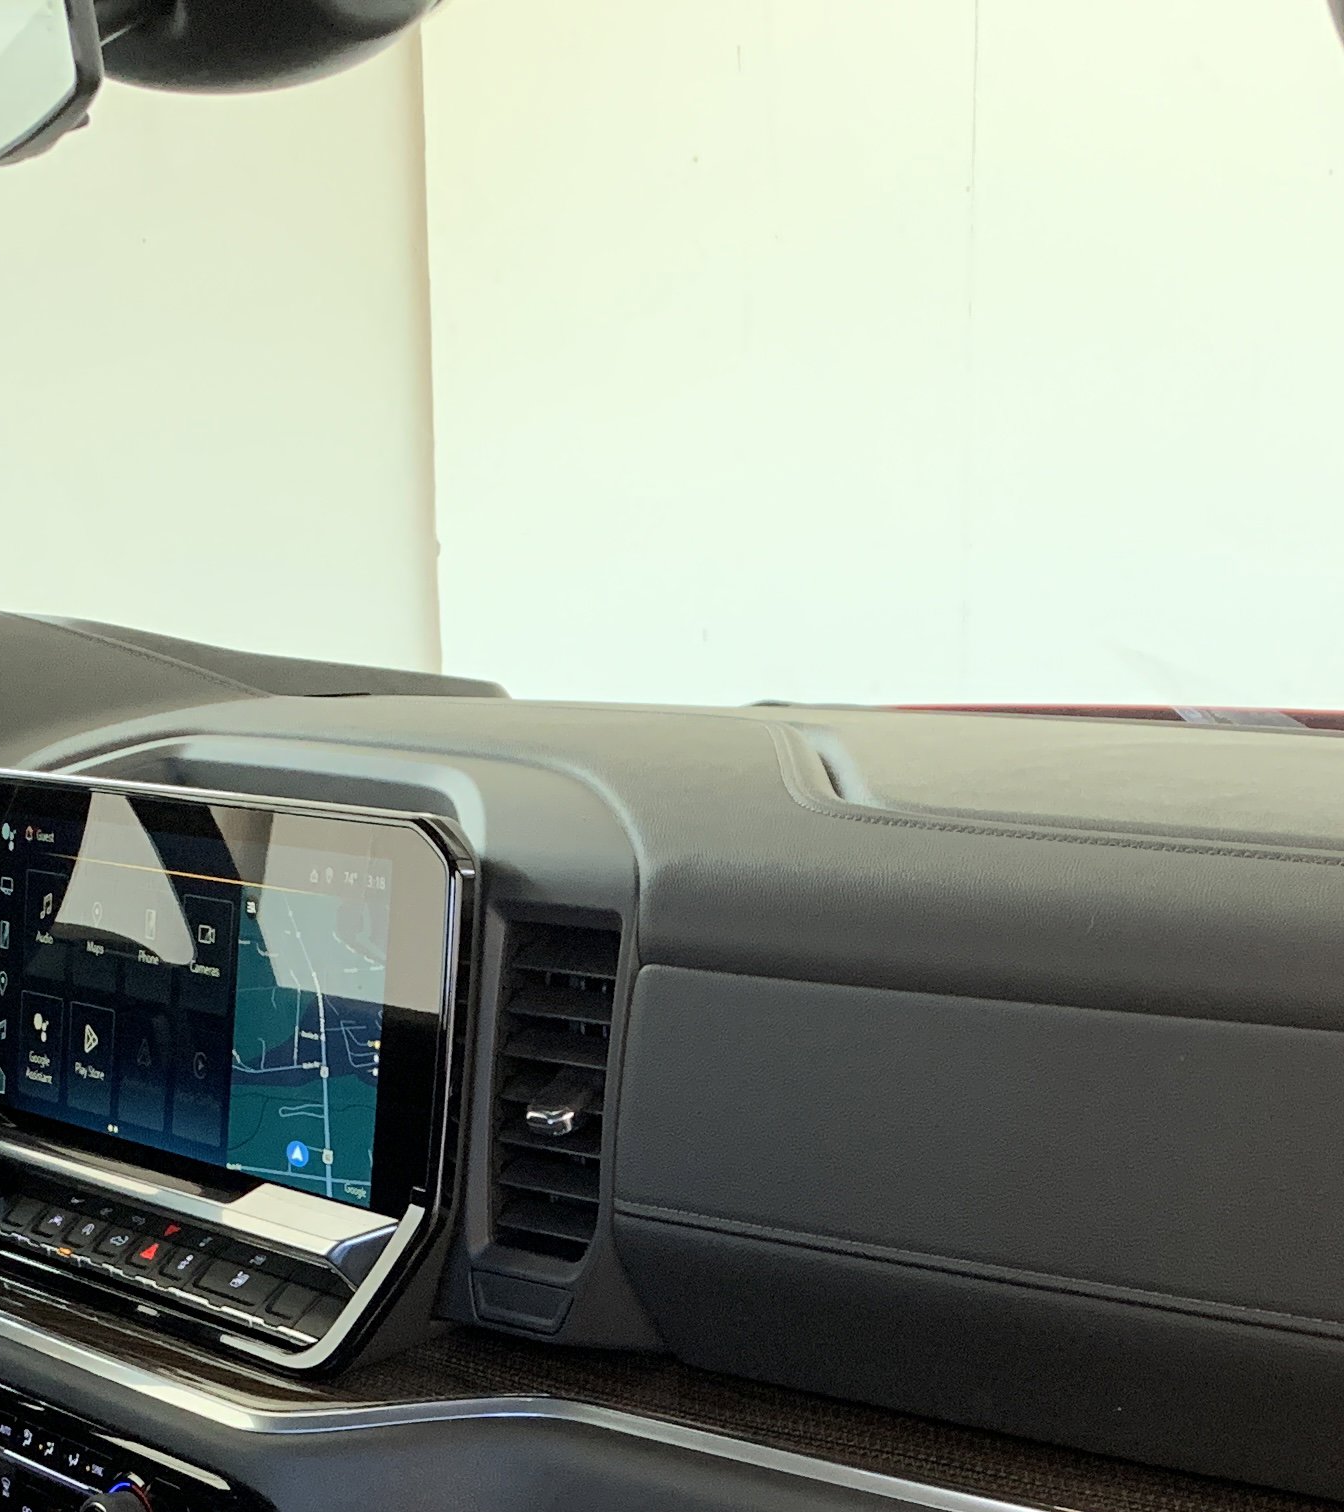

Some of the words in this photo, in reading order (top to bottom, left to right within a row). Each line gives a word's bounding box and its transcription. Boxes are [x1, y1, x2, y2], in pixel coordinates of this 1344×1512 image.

[36, 829, 54, 842] Guest
[36, 931, 53, 945] Audio
[87, 942, 104, 956] Maps
[138, 950, 159, 965] Phone
[190, 961, 220, 977] Cameras
[29, 1051, 51, 1068] Google
[26, 1067, 52, 1084] Assistant
[75, 1062, 87, 1079] Play
[88, 1065, 105, 1081] Store
[344, 1182, 367, 1199] Google
